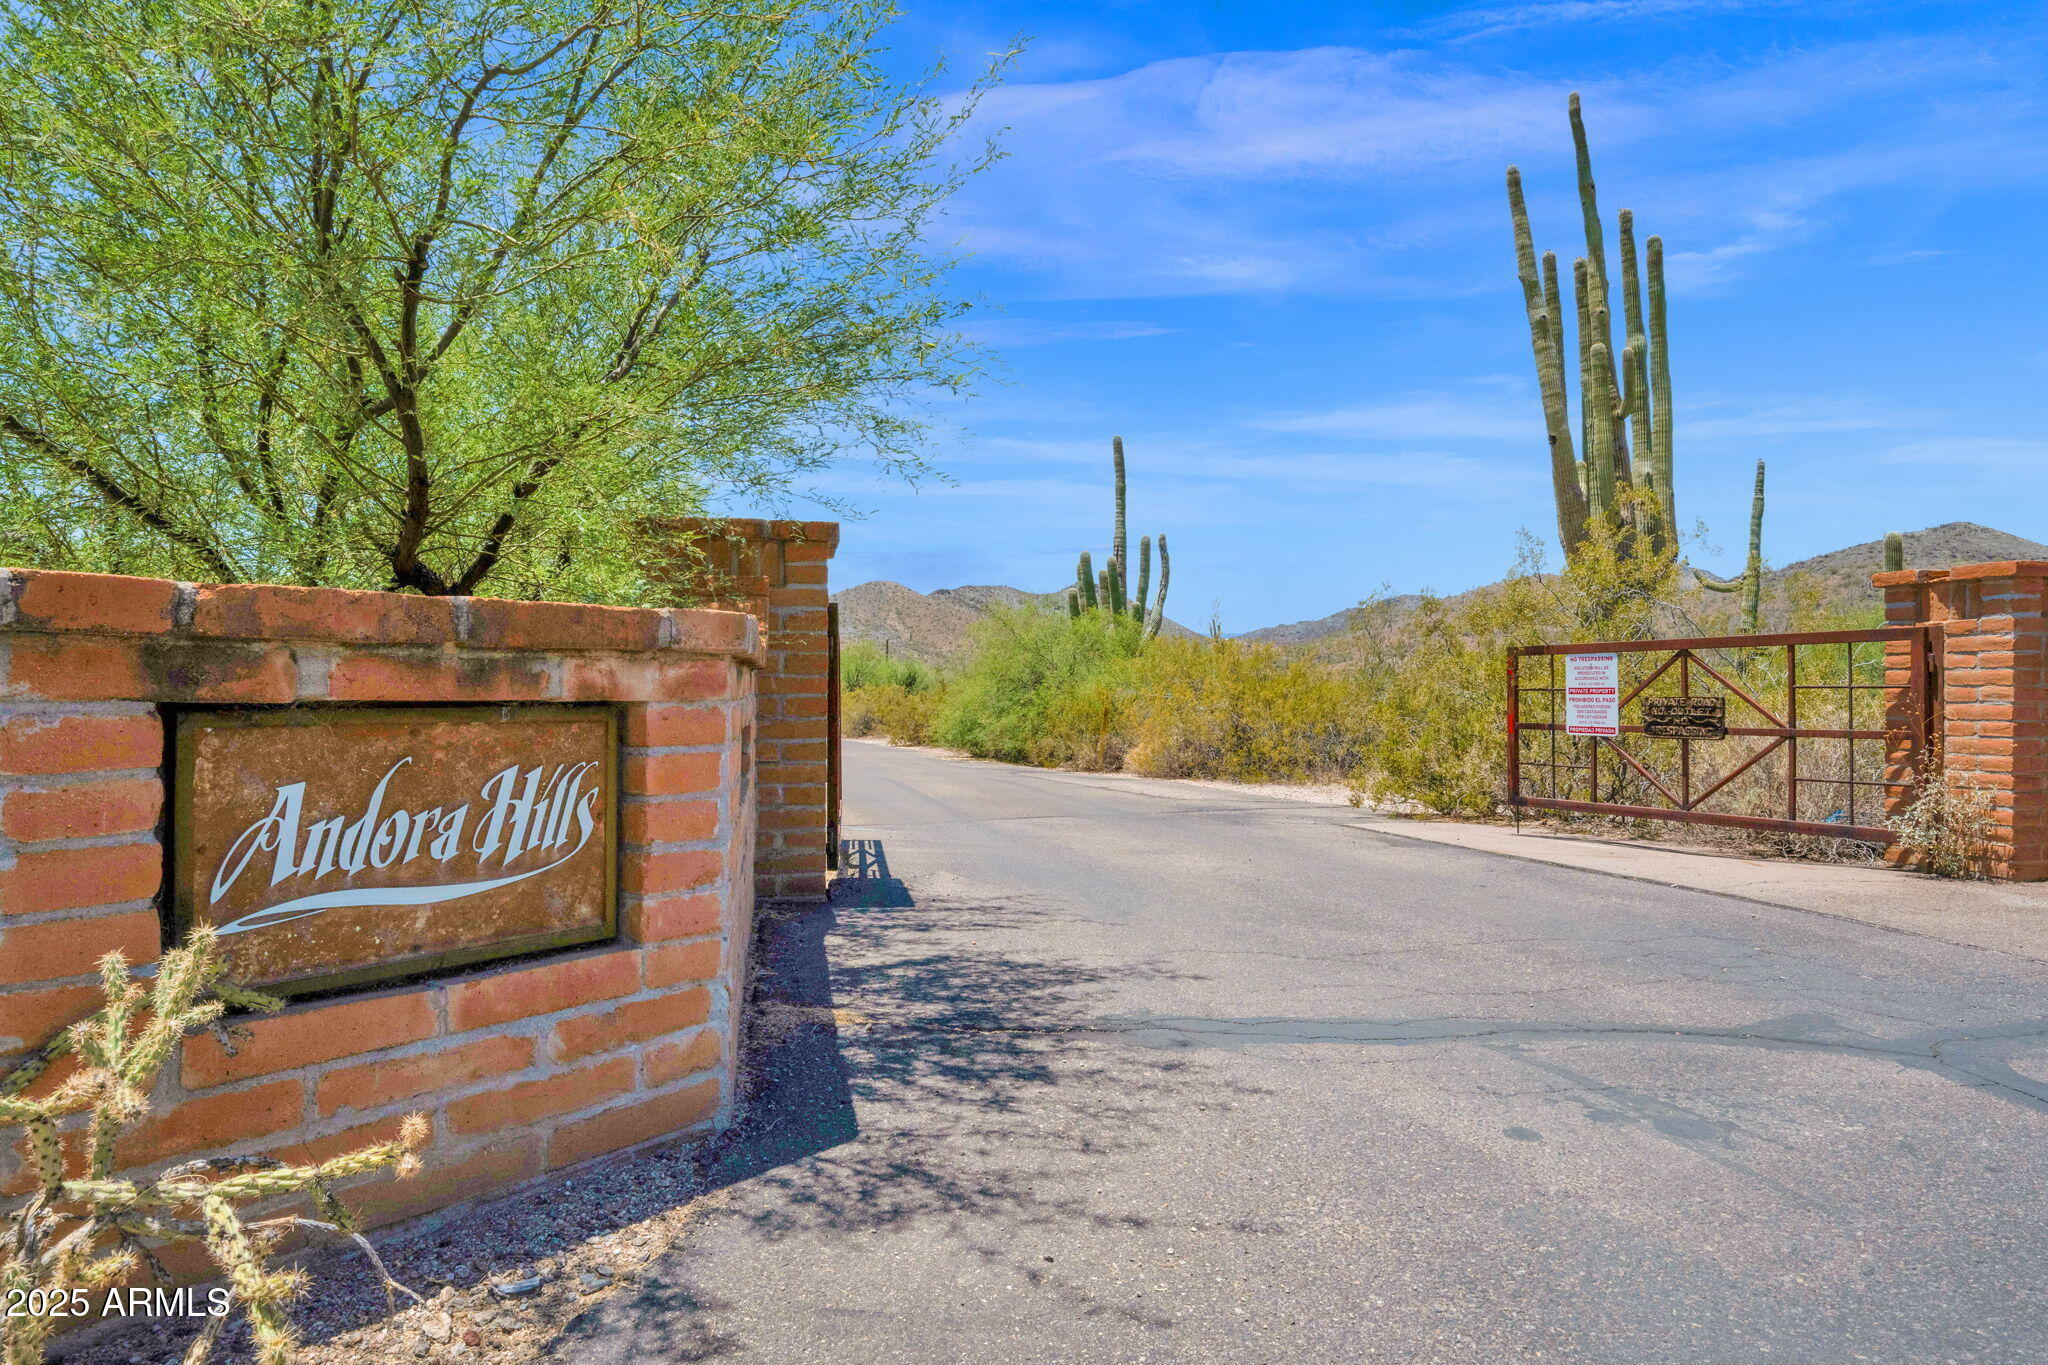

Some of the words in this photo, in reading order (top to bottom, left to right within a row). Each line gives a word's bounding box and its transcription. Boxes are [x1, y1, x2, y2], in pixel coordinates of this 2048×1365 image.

[1648, 697, 1687, 706] PRIVATE
[1690, 697, 1716, 706] ROAD
[1650, 707, 1665, 715] NO
[1670, 707, 1712, 716] OUTLET
[1651, 726, 1714, 736] TRESPASSING
[210, 756, 470, 904] Andora
[473, 760, 600, 870] Hills
